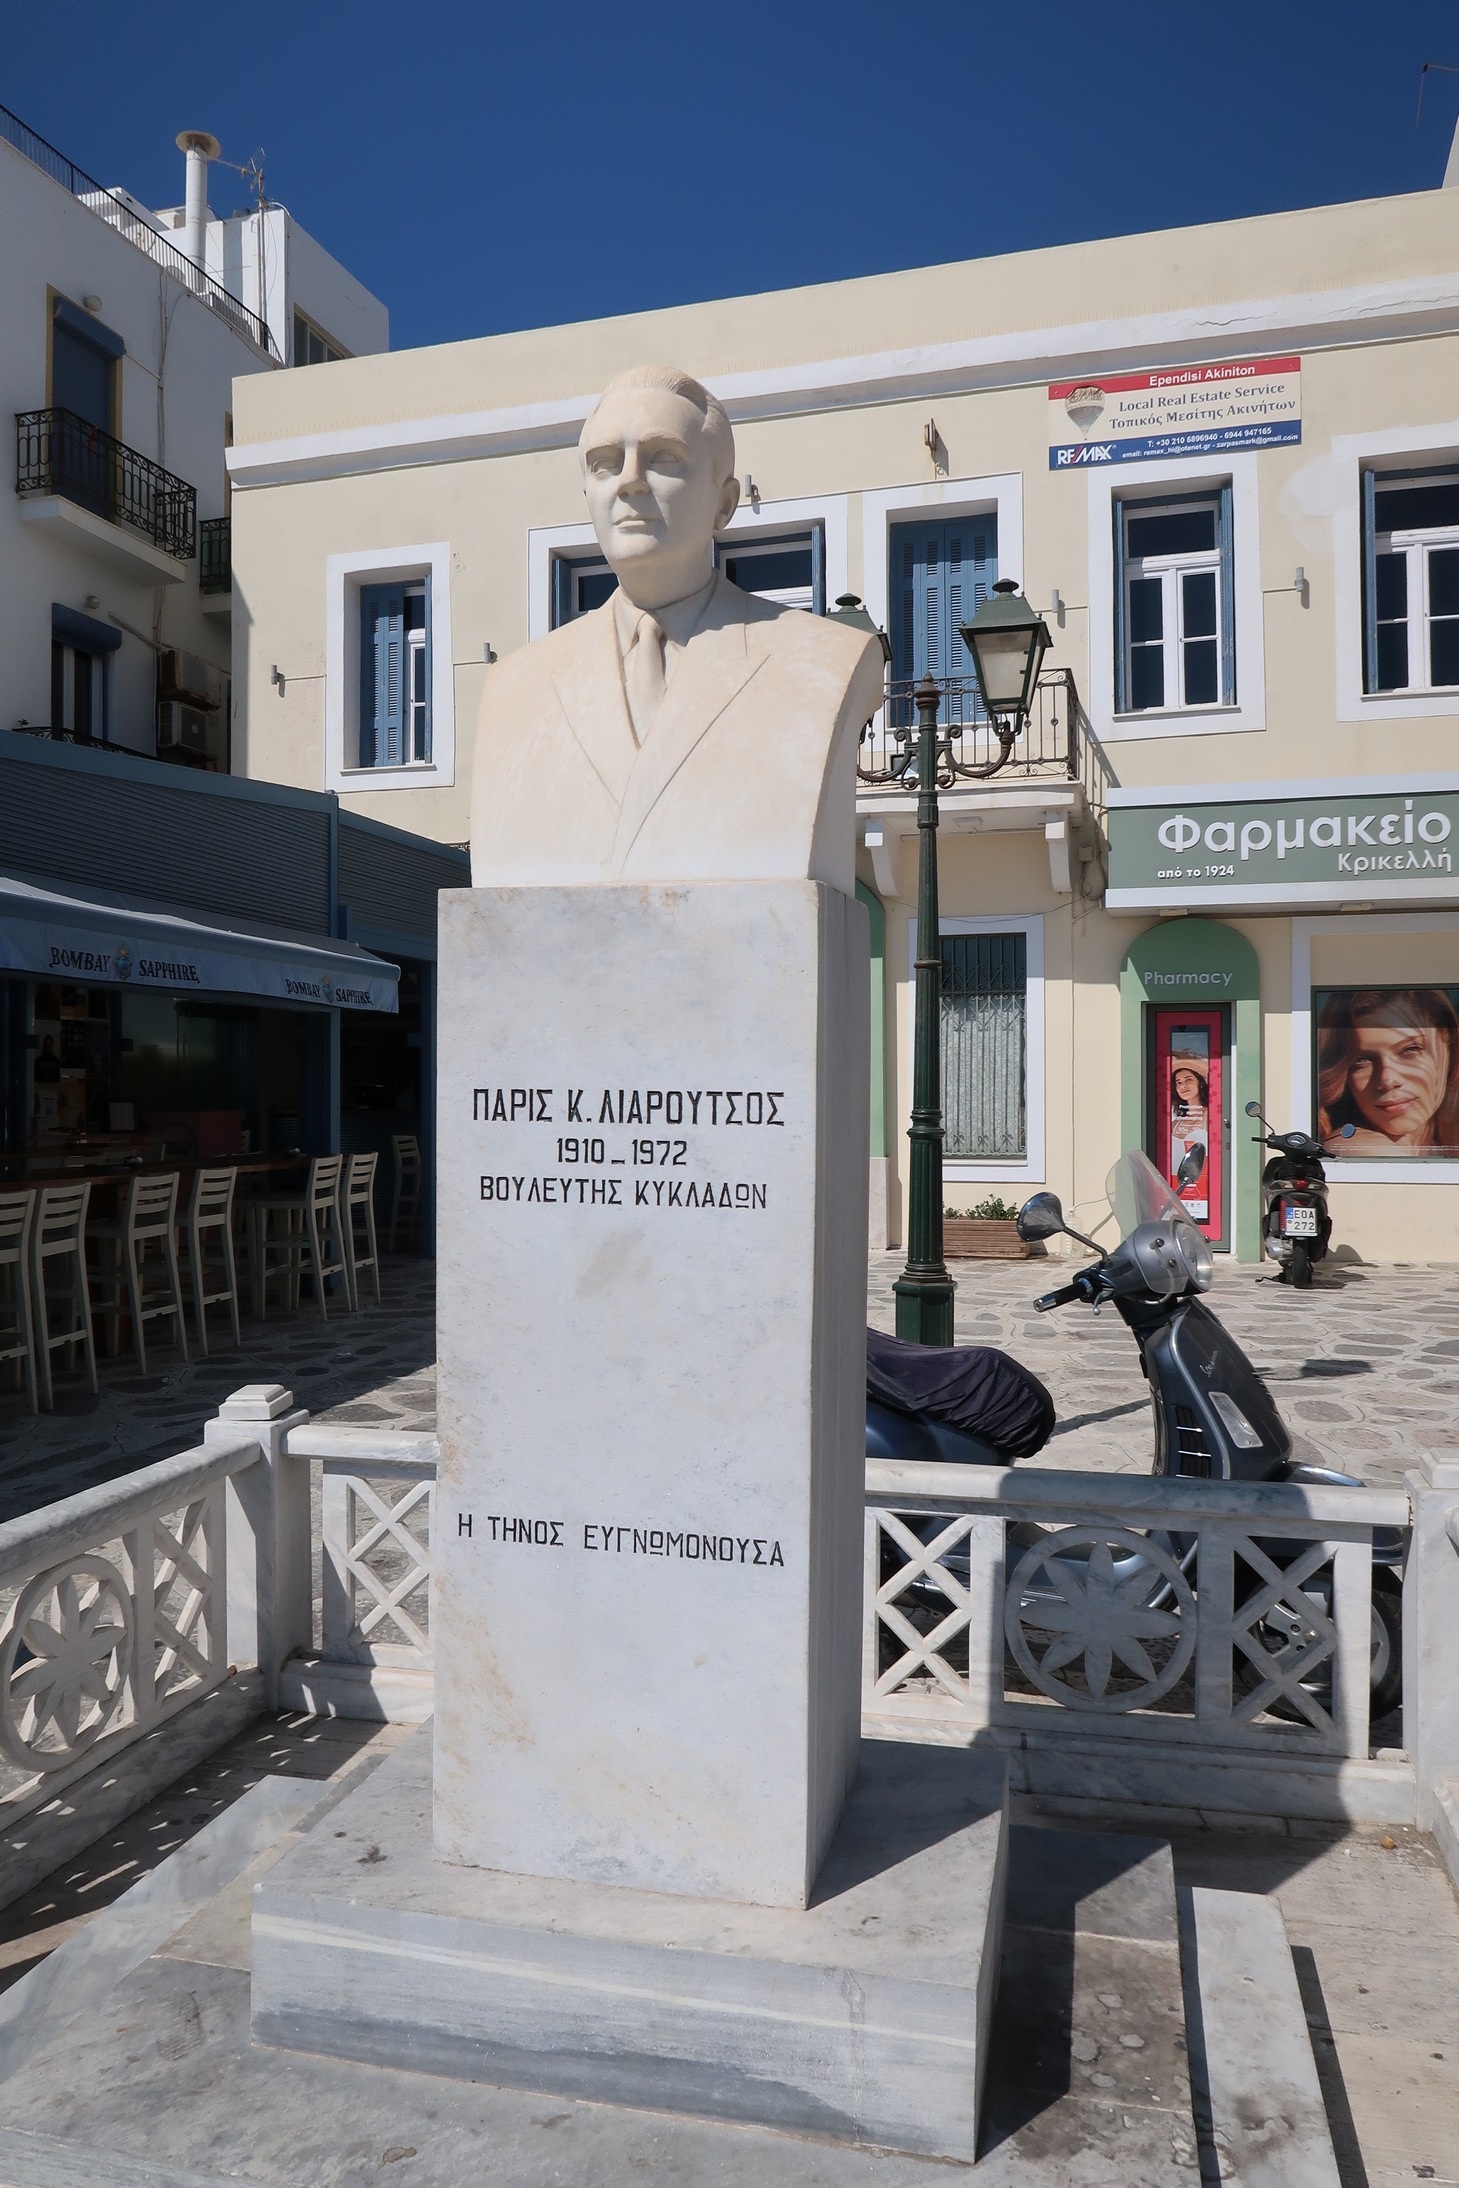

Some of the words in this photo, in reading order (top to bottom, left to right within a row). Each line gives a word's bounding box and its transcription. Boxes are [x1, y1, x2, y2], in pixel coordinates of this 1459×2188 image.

[1149, 369, 1202, 388] Ependisi
[1204, 365, 1256, 380] Akiniton
[1119, 397, 1154, 412] Local
[1158, 393, 1186, 408] Real
[1190, 389, 1231, 403] Estate
[1235, 383, 1285, 398] Service
[1109, 411, 1162, 430] Τοπικός
[1166, 406, 1223, 423] Μεσίτης
[1226, 399, 1297, 416] Ακινήτων
[1147, 440, 1154, 448] T:
[1156, 439, 1170, 447] +30
[1171, 437, 1185, 445] 210
[1224, 430, 1243, 439] 6944
[1244, 426, 1272, 437] 947165
[1121, 450, 1143, 458] email:
[1157, 800, 1452, 861] Φαρμακείο
[1157, 865, 1181, 879] από
[1186, 866, 1201, 878] το
[1204, 864, 1235, 878] 1924
[1337, 848, 1452, 876] Κρικελλή
[49, 946, 111, 973] BOMBAY
[138, 959, 200, 983] SAPPHIRE
[285, 979, 321, 998] BOMBAY
[335, 988, 374, 1005] SAPPHIRE
[1144, 971, 1233, 987] Pharmacy
[473, 1088, 553, 1123] ΠΑΡΙΣ
[480, 1175, 622, 1206] ΒΟΥΛΕΥΤΗΣ
[635, 1180, 767, 1210] ΚΥΚΛΑΔΩΝ
[1294, 1221, 1315, 1231] 272
[458, 1513, 472, 1538] Η
[487, 1516, 564, 1547] ΤΗΝΟΣ
[584, 1524, 784, 1567] ΕΥΓΝΩΜΟΝΟΥΣΑ
